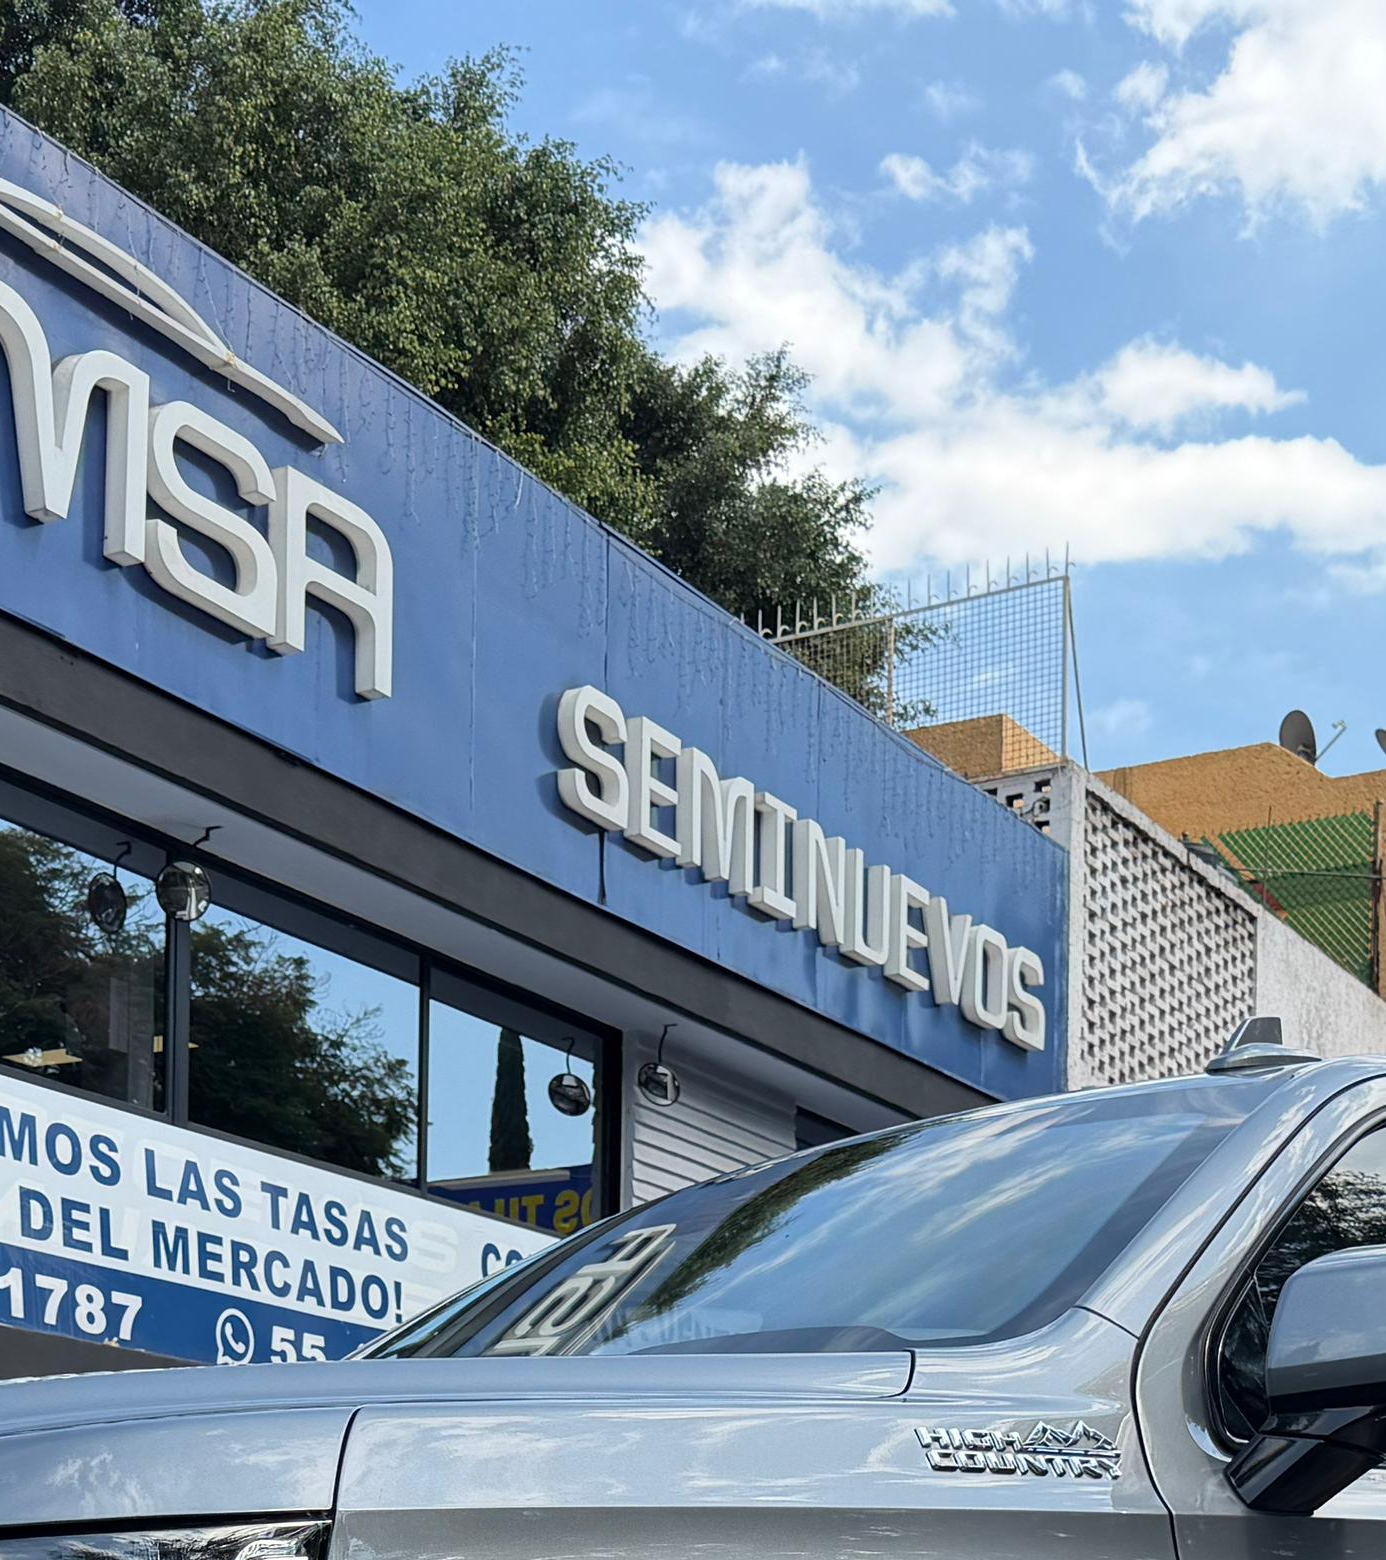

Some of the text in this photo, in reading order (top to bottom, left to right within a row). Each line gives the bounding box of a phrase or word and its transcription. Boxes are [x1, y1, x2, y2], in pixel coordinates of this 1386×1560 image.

[557, 685, 1045, 1051] SEMINUEVOS
[145, 1148, 242, 1218] LAS
[261, 1181, 409, 1262] TASAS
[19, 1185, 129, 1261] DEL
[152, 1219, 403, 1324] MERCADO!
[270, 1325, 327, 1364] 55
[915, 1427, 1027, 1452] HIGH
[926, 1450, 1123, 1480] COUNTRY
